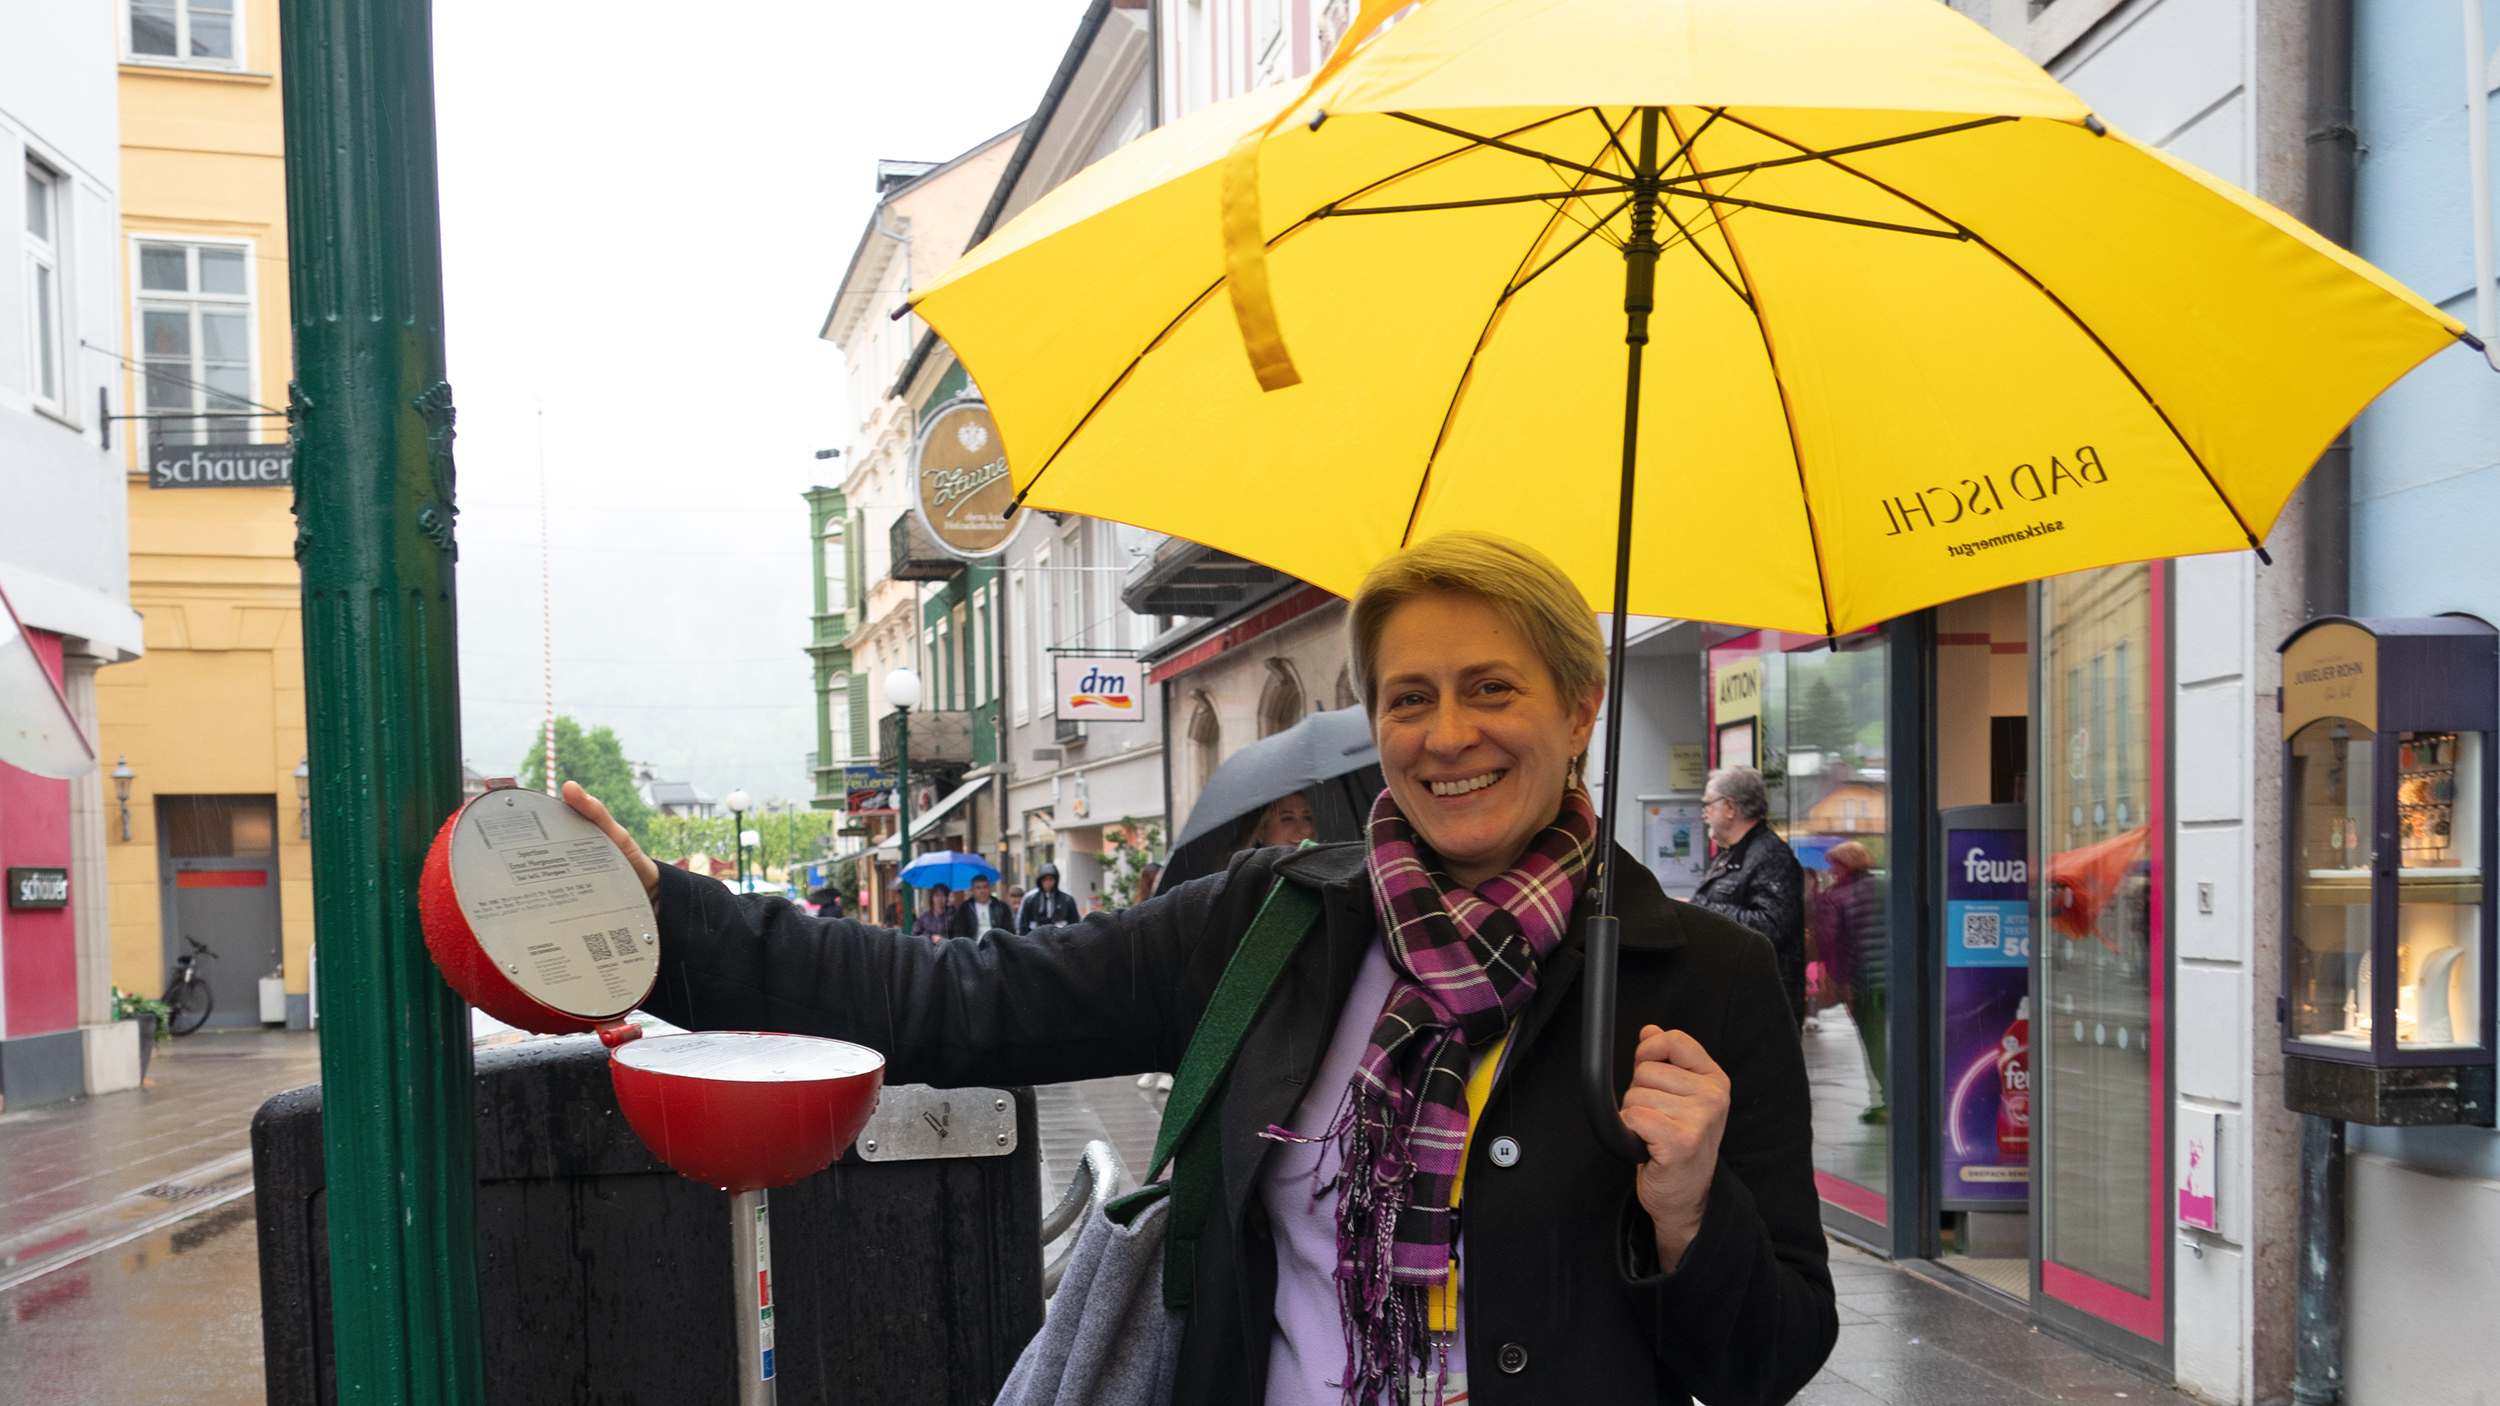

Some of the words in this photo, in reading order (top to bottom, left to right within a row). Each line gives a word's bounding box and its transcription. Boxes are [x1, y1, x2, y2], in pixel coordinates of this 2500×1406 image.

[156, 451, 293, 483] schauer
[921, 456, 1009, 507] Zaune
[1080, 667, 1125, 693] dm
[1719, 668, 1757, 704] AKTION
[1963, 847, 2027, 883] fewa
[20, 872, 68, 901] schauer
